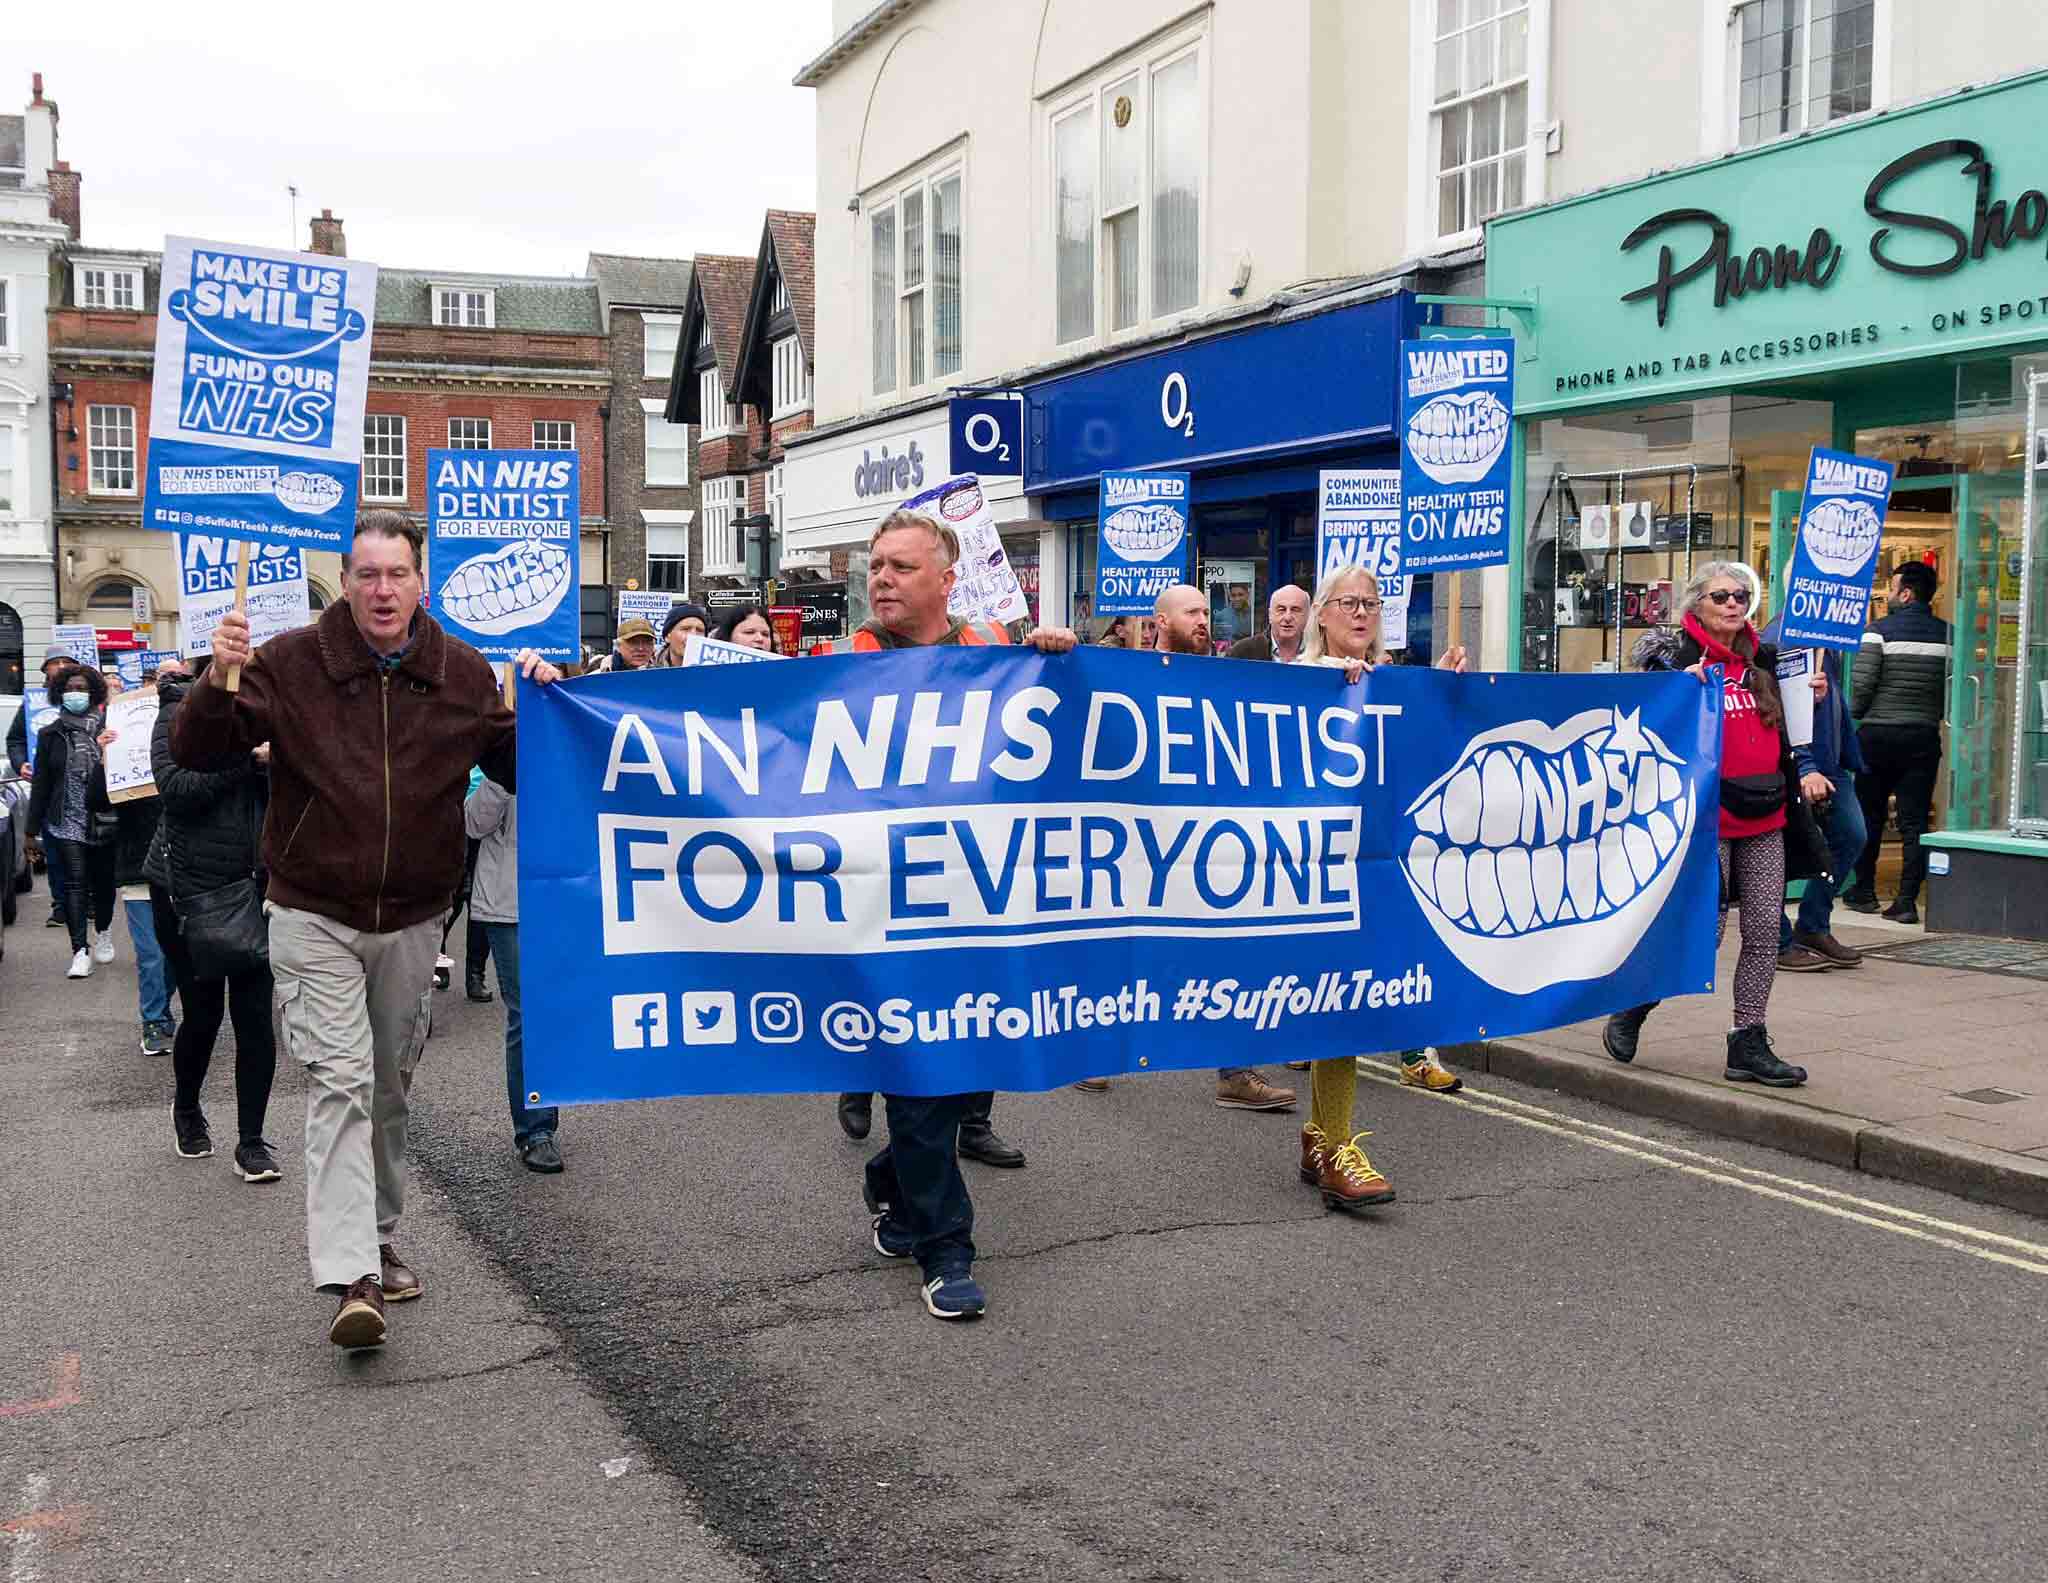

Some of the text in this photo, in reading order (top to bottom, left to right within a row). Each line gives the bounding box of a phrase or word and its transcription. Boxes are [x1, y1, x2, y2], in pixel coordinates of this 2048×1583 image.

[1620, 139, 2048, 328] Phone Sho
[196, 253, 341, 296] MAKE US
[192, 281, 339, 333] SMILE
[1556, 369, 1616, 392] PHONE
[1625, 360, 1664, 381] AND
[1672, 352, 1711, 374] TAB
[1720, 324, 1880, 366] ACCESSORIES
[1931, 309, 1967, 331] ON
[1979, 297, 2048, 325] SPOT
[189, 353, 334, 391] FUND OUR
[1408, 349, 1507, 379] WANTED
[182, 378, 332, 442] NHS
[1161, 372, 1195, 438] O2
[965, 413, 1010, 462] O2
[162, 467, 277, 480] AN NHS DENTIST
[162, 480, 260, 492] FOR EVERYONE
[436, 460, 572, 489] AN NHS
[854, 440, 924, 498] claire's
[1106, 478, 1185, 496] WANTED
[1815, 457, 1888, 492] WANTED
[438, 493, 570, 518] DENTIST
[1407, 489, 1504, 512] HEALTHY TEETH
[270, 521, 341, 541] #SuffolkTeeth
[438, 521, 569, 537] FOR EVERYONE
[1325, 521, 1368, 536] BRING
[1408, 507, 1504, 542] ON NHS
[187, 556, 299, 593] DENISTS
[485, 551, 545, 592] NHS
[1102, 567, 1180, 578] HEALTHY TEETH
[1324, 536, 1400, 578] NHS
[1102, 578, 1132, 597] ON
[1794, 577, 1867, 600] HEALTHY TEETH
[1791, 591, 1864, 625] ON NHS
[602, 687, 1402, 795] AN NHS DENTIST
[1521, 742, 1632, 846] NHS
[614, 817, 1352, 924] FOR EVERYONE
[821, 962, 1433, 1053] @SuffolkTeeth #SuffolkTeeth
